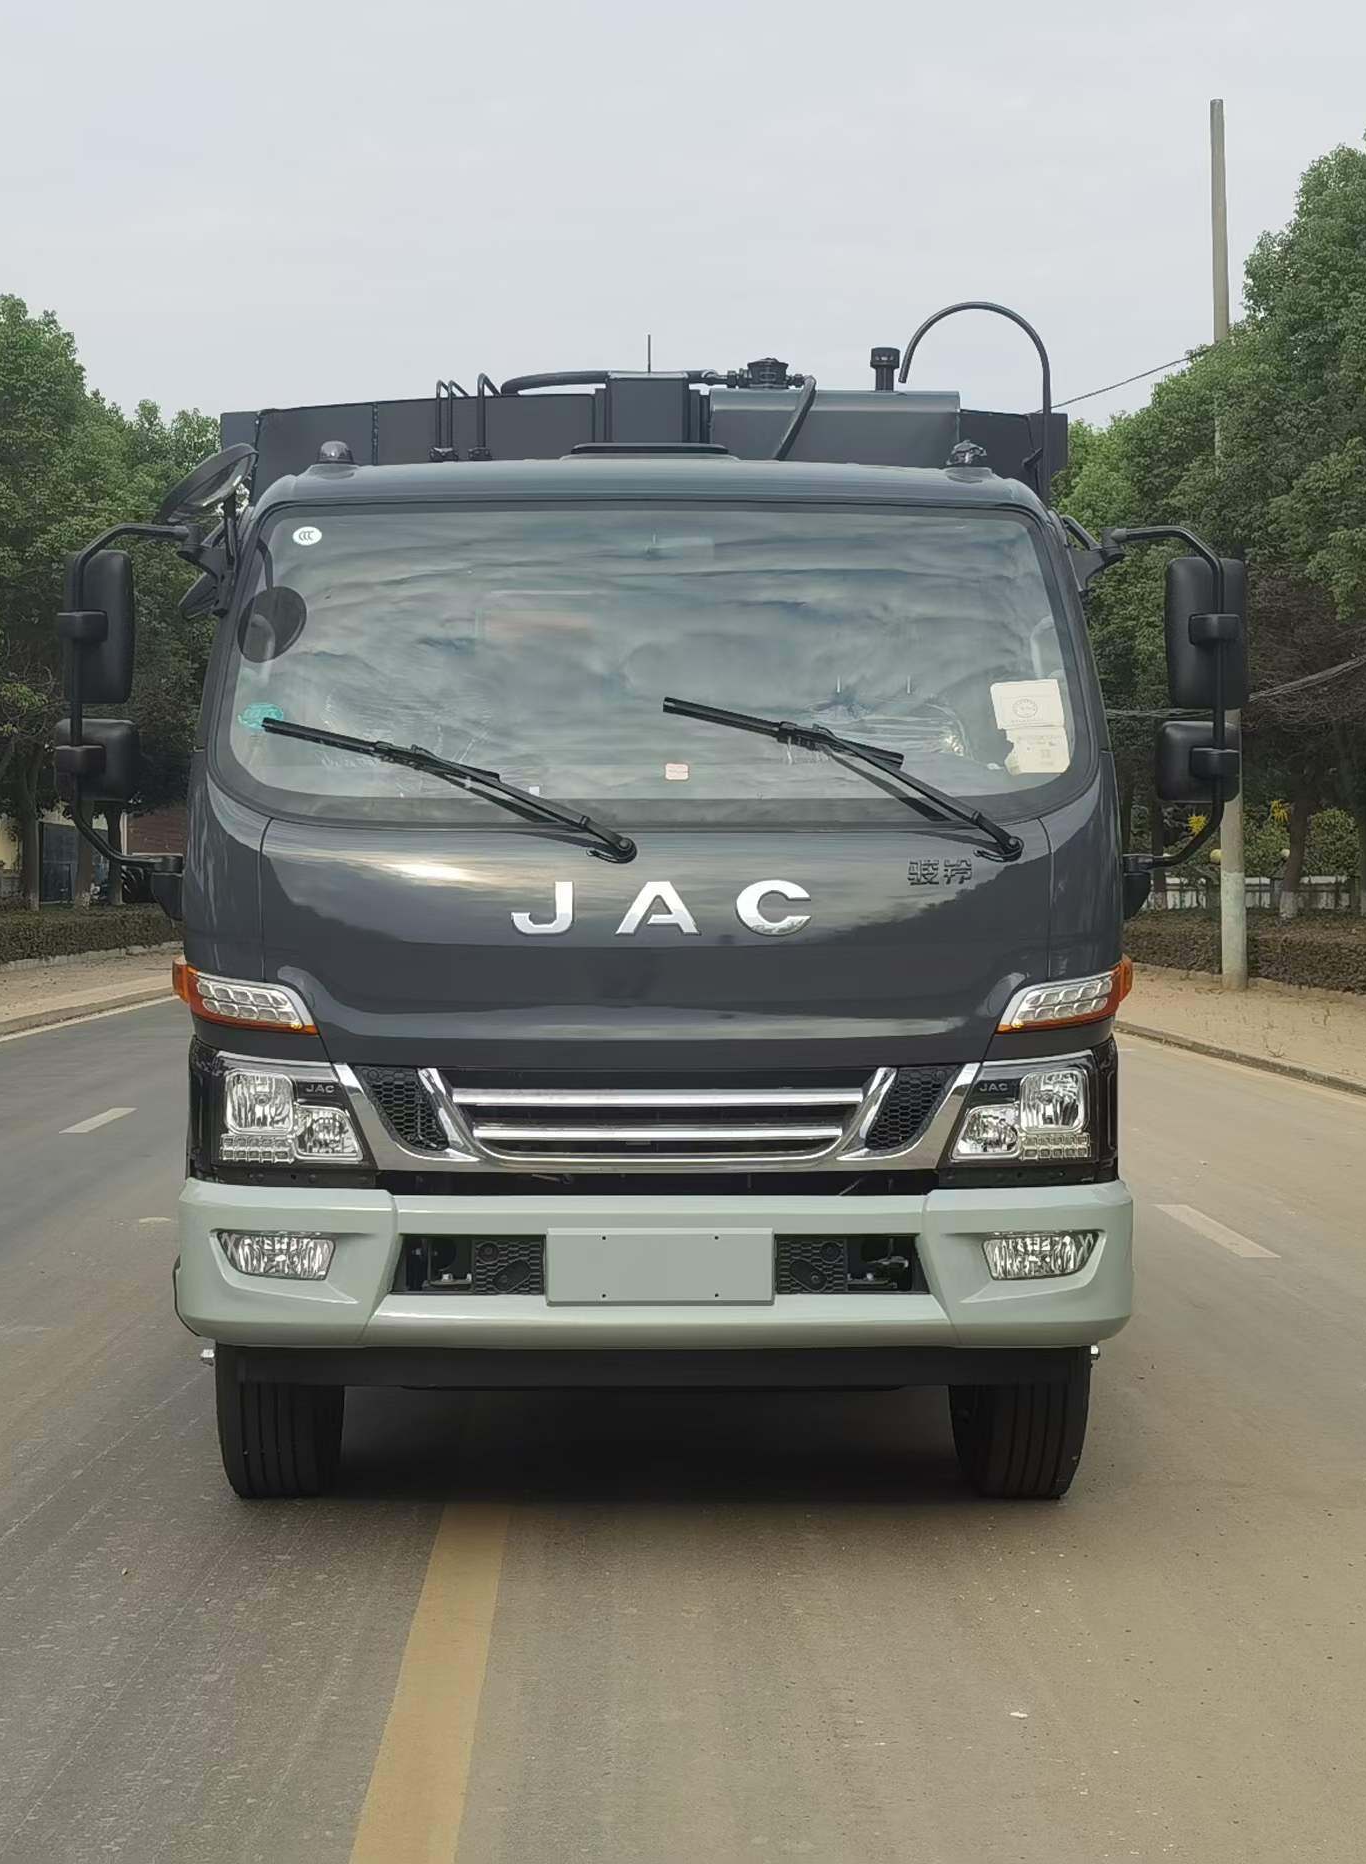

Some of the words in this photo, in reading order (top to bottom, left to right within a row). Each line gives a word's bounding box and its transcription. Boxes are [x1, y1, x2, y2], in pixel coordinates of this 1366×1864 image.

[511, 879, 812, 936] JAC
[306, 1084, 335, 1093] JAC
[980, 1083, 1008, 1092] JAC
